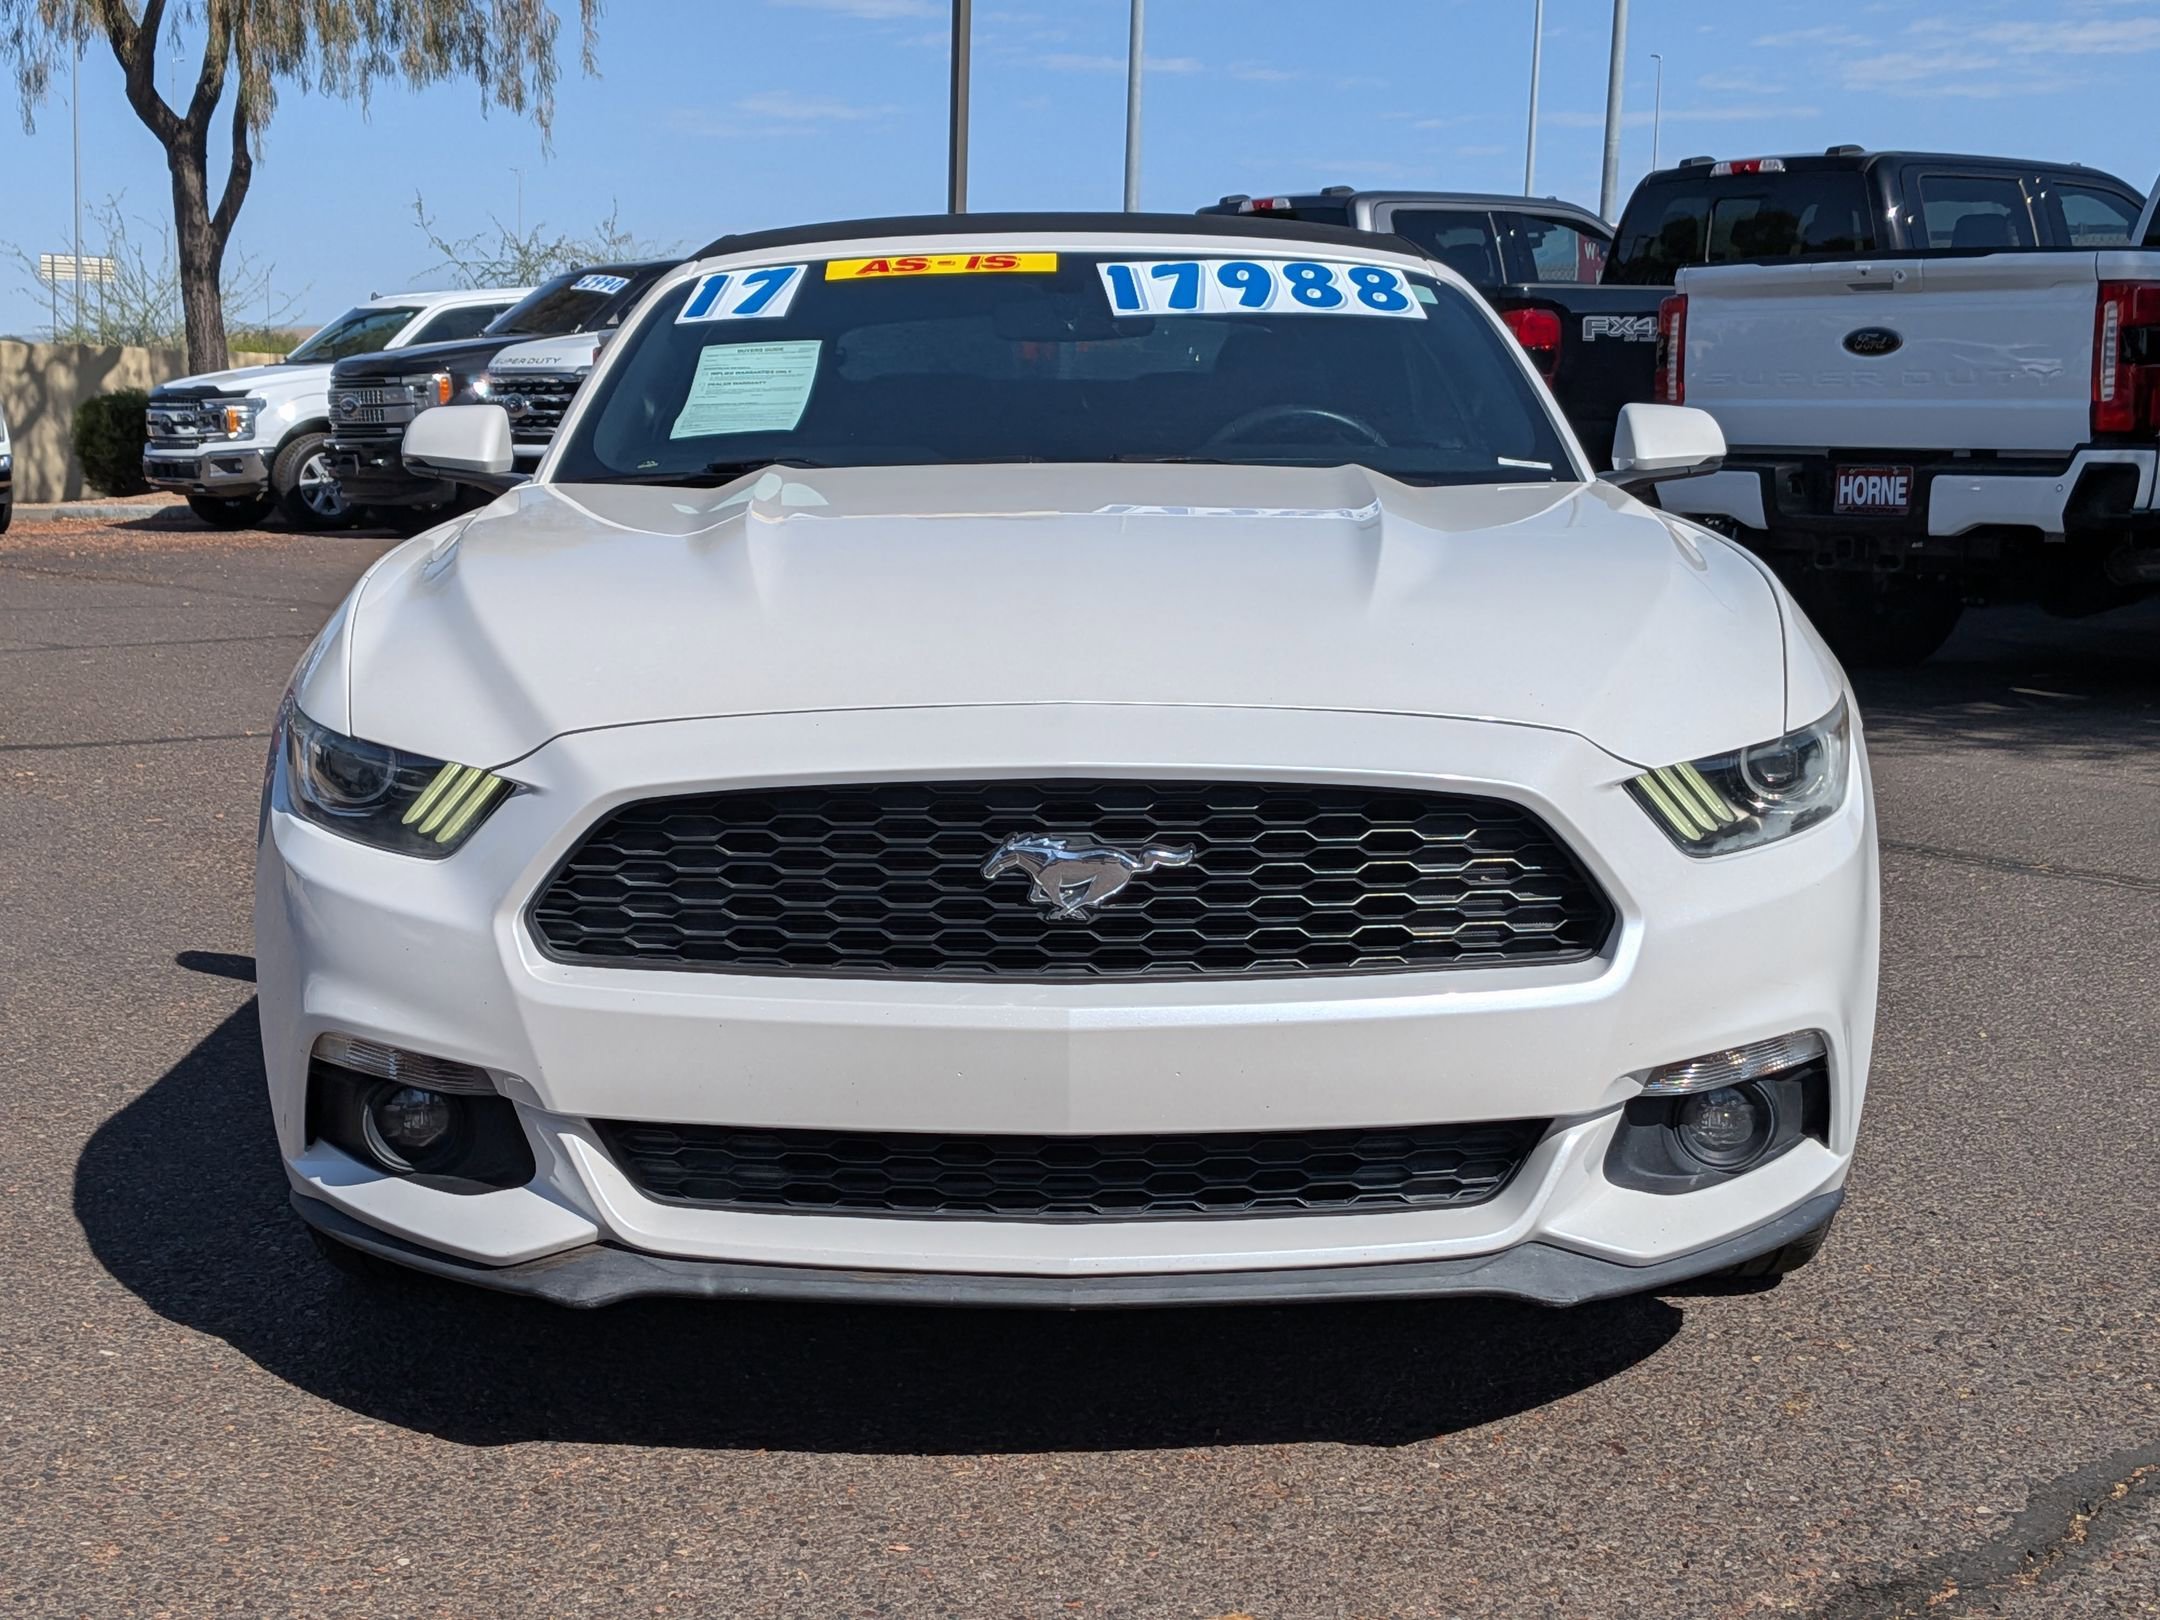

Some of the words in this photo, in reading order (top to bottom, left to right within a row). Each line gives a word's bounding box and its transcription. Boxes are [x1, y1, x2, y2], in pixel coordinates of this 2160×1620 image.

[683, 266, 798, 318] 17
[1106, 261, 1412, 312] 17988
[1582, 316, 1657, 342] FX4
[495, 357, 527, 365] SUPER
[528, 356, 562, 364] DUTY
[1703, 368, 1885, 387] SUPER
[1901, 366, 2064, 387] DUTY
[1838, 475, 1908, 506] HORNE
